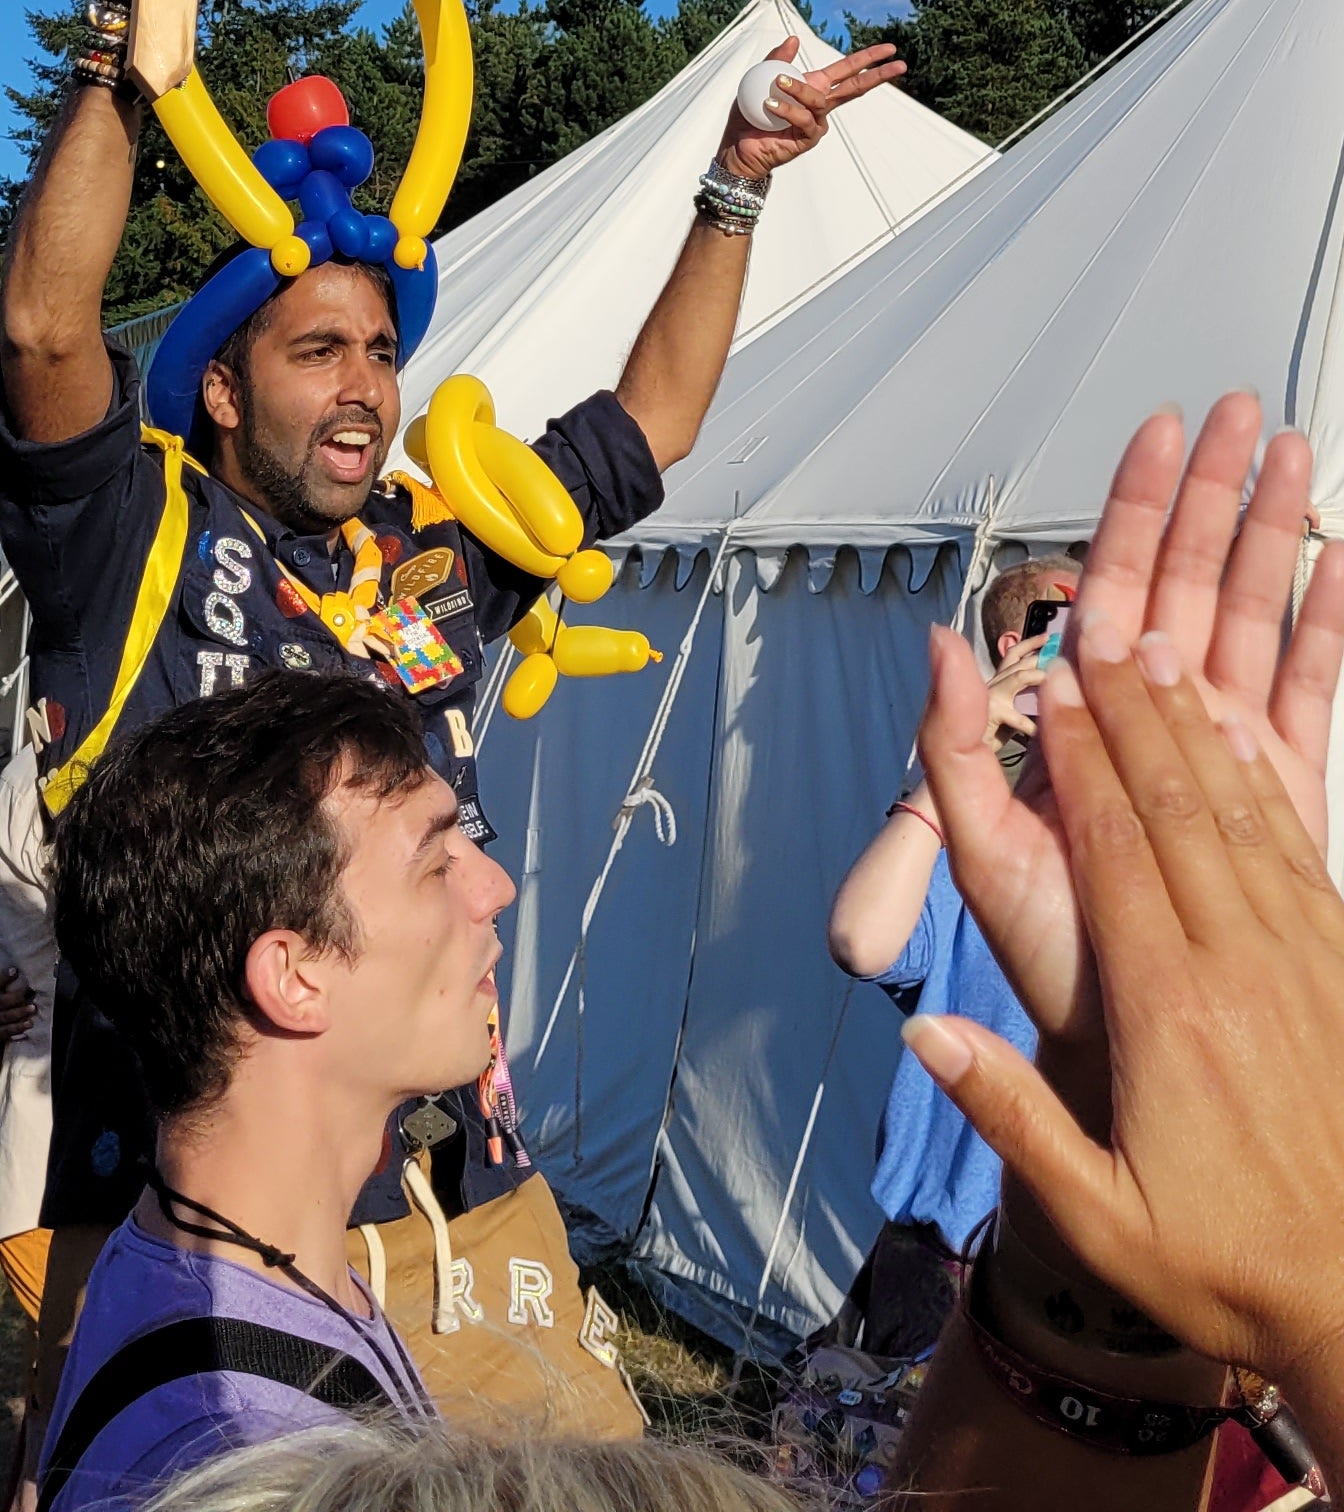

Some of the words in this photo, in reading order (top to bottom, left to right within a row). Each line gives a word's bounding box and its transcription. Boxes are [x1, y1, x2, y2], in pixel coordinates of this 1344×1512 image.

[434, 595, 467, 615] WILDKIND
[444, 709, 474, 758] B
[1059, 1396, 1103, 1427] 10
